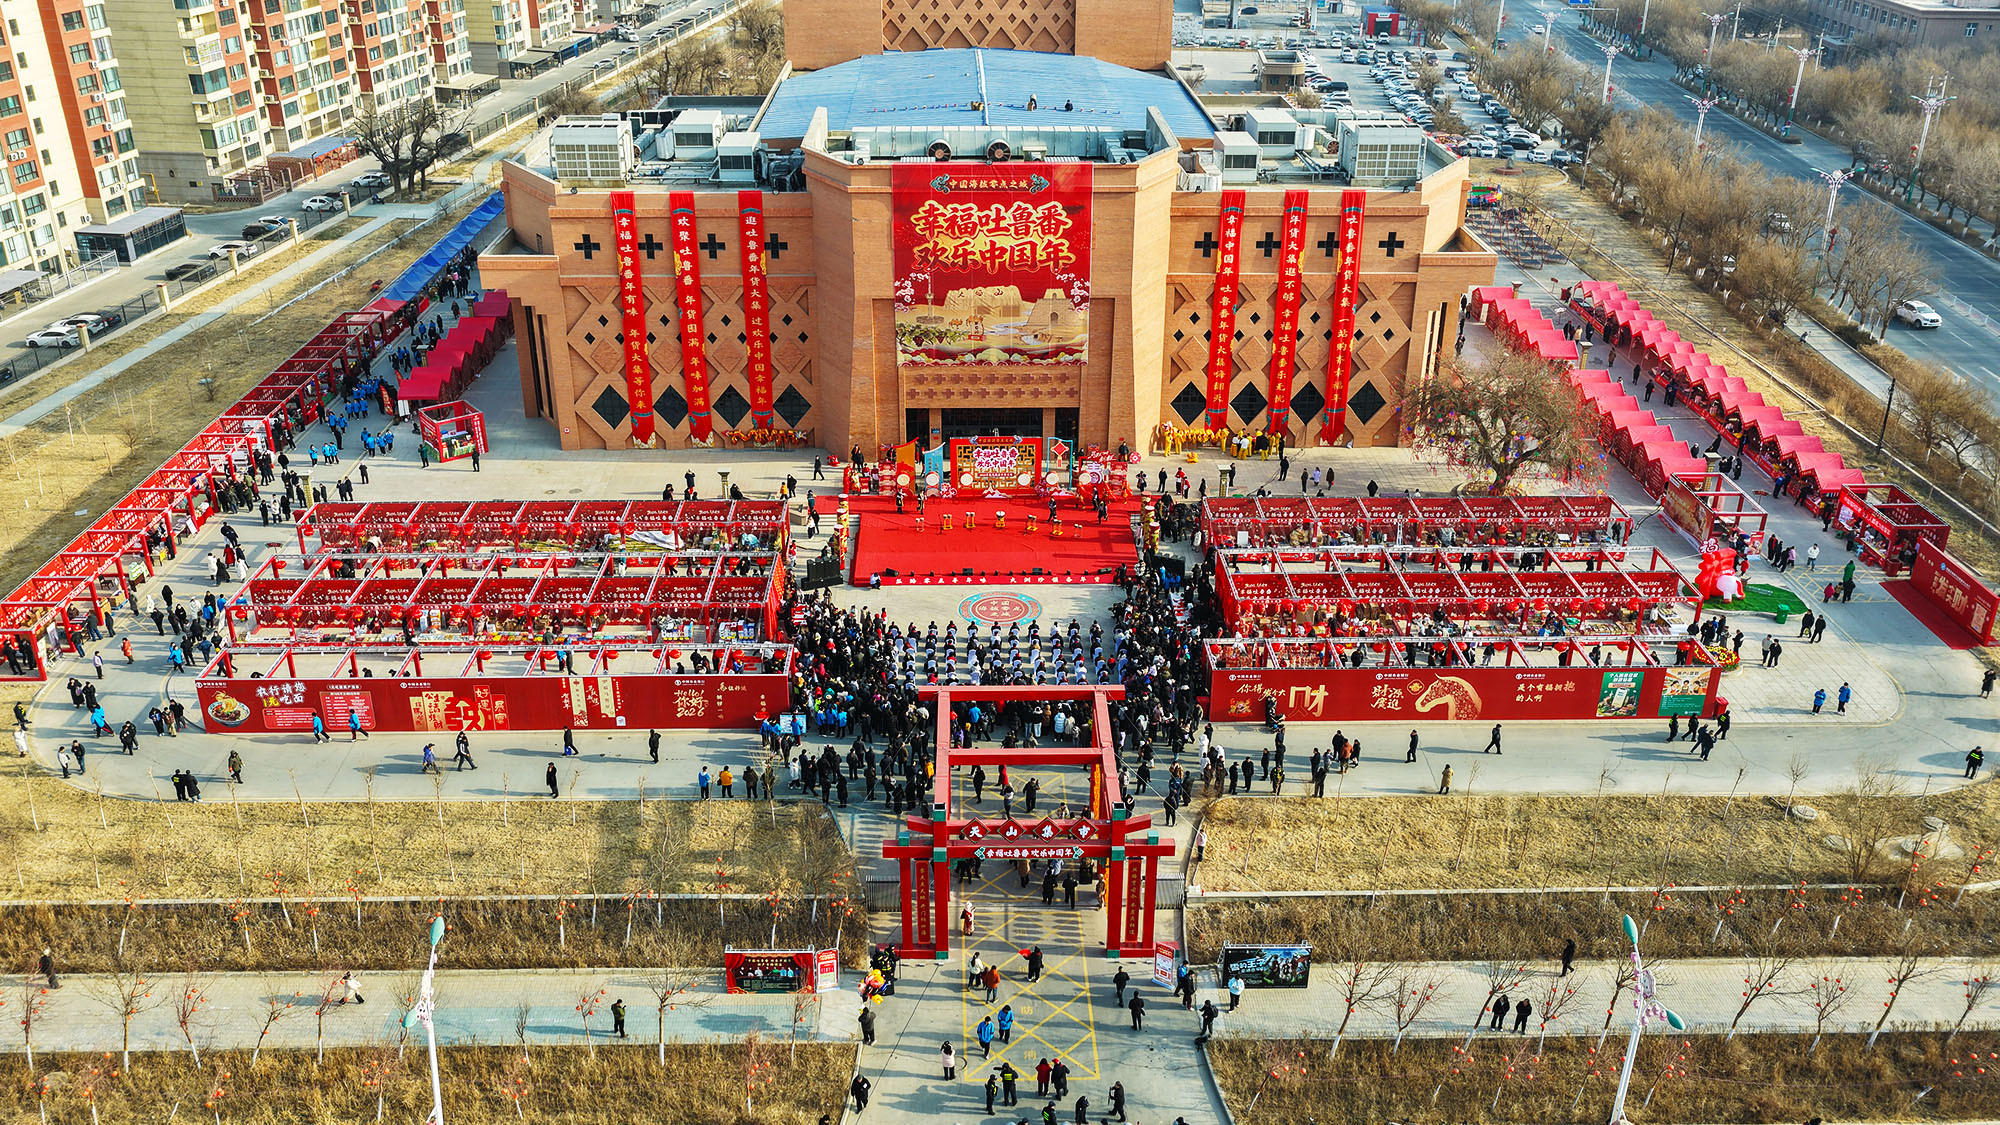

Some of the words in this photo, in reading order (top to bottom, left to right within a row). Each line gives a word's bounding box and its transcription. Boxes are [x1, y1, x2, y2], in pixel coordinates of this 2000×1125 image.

[949, 179, 1029, 190] 中国海拔零点之城
[911, 200, 1073, 240] 幸福吐鲁番
[912, 239, 1076, 274] 欢乐中国年
[1221, 215, 1238, 276] 幸福中国年
[1283, 215, 1301, 302] 年货大集逛不够
[1340, 216, 1358, 308] 吐鲁番年货大集
[619, 217, 638, 317] 幸福吐鲁番年有味
[629, 329, 647, 409] 年货大集等你来
[677, 217, 694, 286] 欢聚吐鲁番
[690, 357, 704, 406] 年味加满
[1213, 285, 1232, 403] 吐鲁番年货大集嗨翻天
[1274, 309, 1294, 403] 幸福吐鲁番乐无忧
[1699, 537, 1719, 553] 福
[255, 681, 306, 698] 农行请您
[262, 694, 304, 707] 1元吃面
[673, 696, 706, 709] 你好
[674, 689, 704, 697] Hello!
[1288, 684, 1329, 717] 财
[675, 707, 705, 718] 2026
[969, 824, 1091, 840] 天山集市
[986, 849, 1029, 858] 幸福吐鲁番
[1031, 848, 1073, 857] 欢乐中国年
